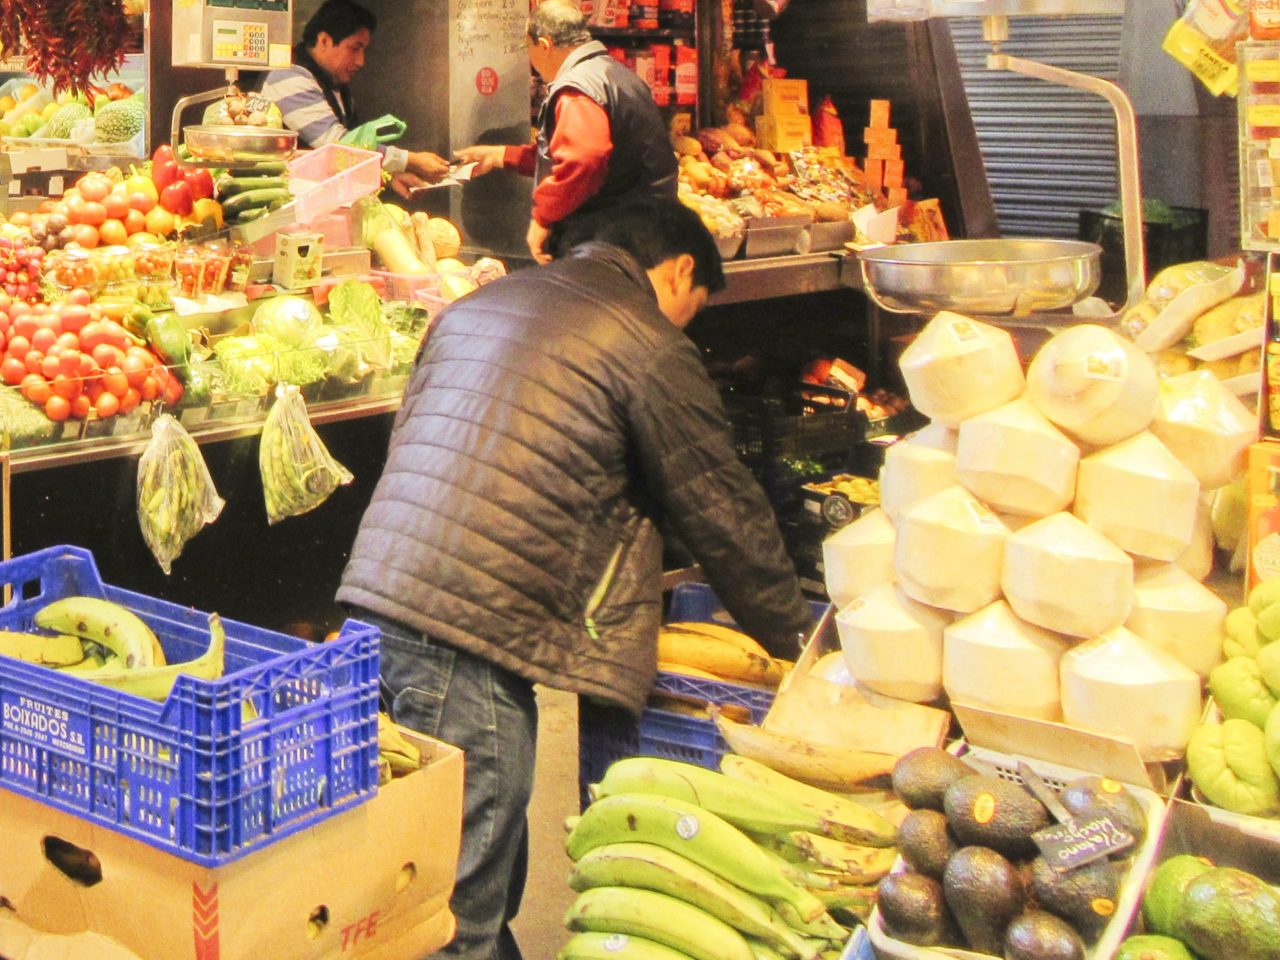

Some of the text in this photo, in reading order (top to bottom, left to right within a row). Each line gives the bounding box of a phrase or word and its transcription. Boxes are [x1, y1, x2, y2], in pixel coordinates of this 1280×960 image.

[1200, 47, 1230, 71] CANELA
[3, 702, 67, 740] BOIXADOS
[20, 696, 69, 721] FRUITES
